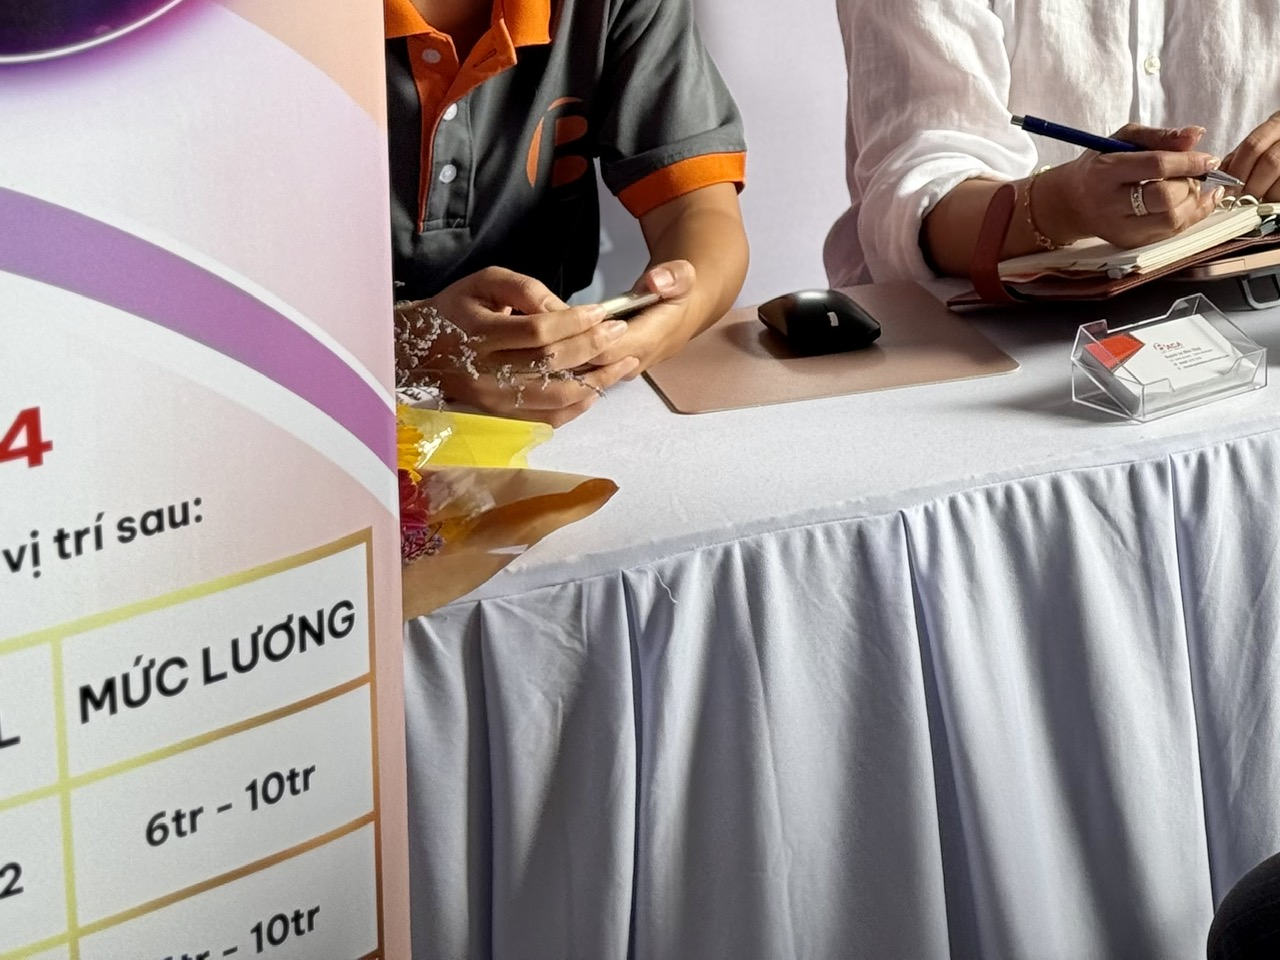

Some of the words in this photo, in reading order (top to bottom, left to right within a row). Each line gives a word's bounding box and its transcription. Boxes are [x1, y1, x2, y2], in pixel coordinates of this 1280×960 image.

[1, 529, 42, 579] vị
[53, 511, 105, 560] trí
[116, 497, 203, 544] sau:
[79, 654, 190, 725] MỨC
[202, 599, 356, 686] LƯƠNG
[145, 805, 205, 848] 6tr
[244, 764, 316, 812] 10tr
[250, 904, 321, 954] 10tr
